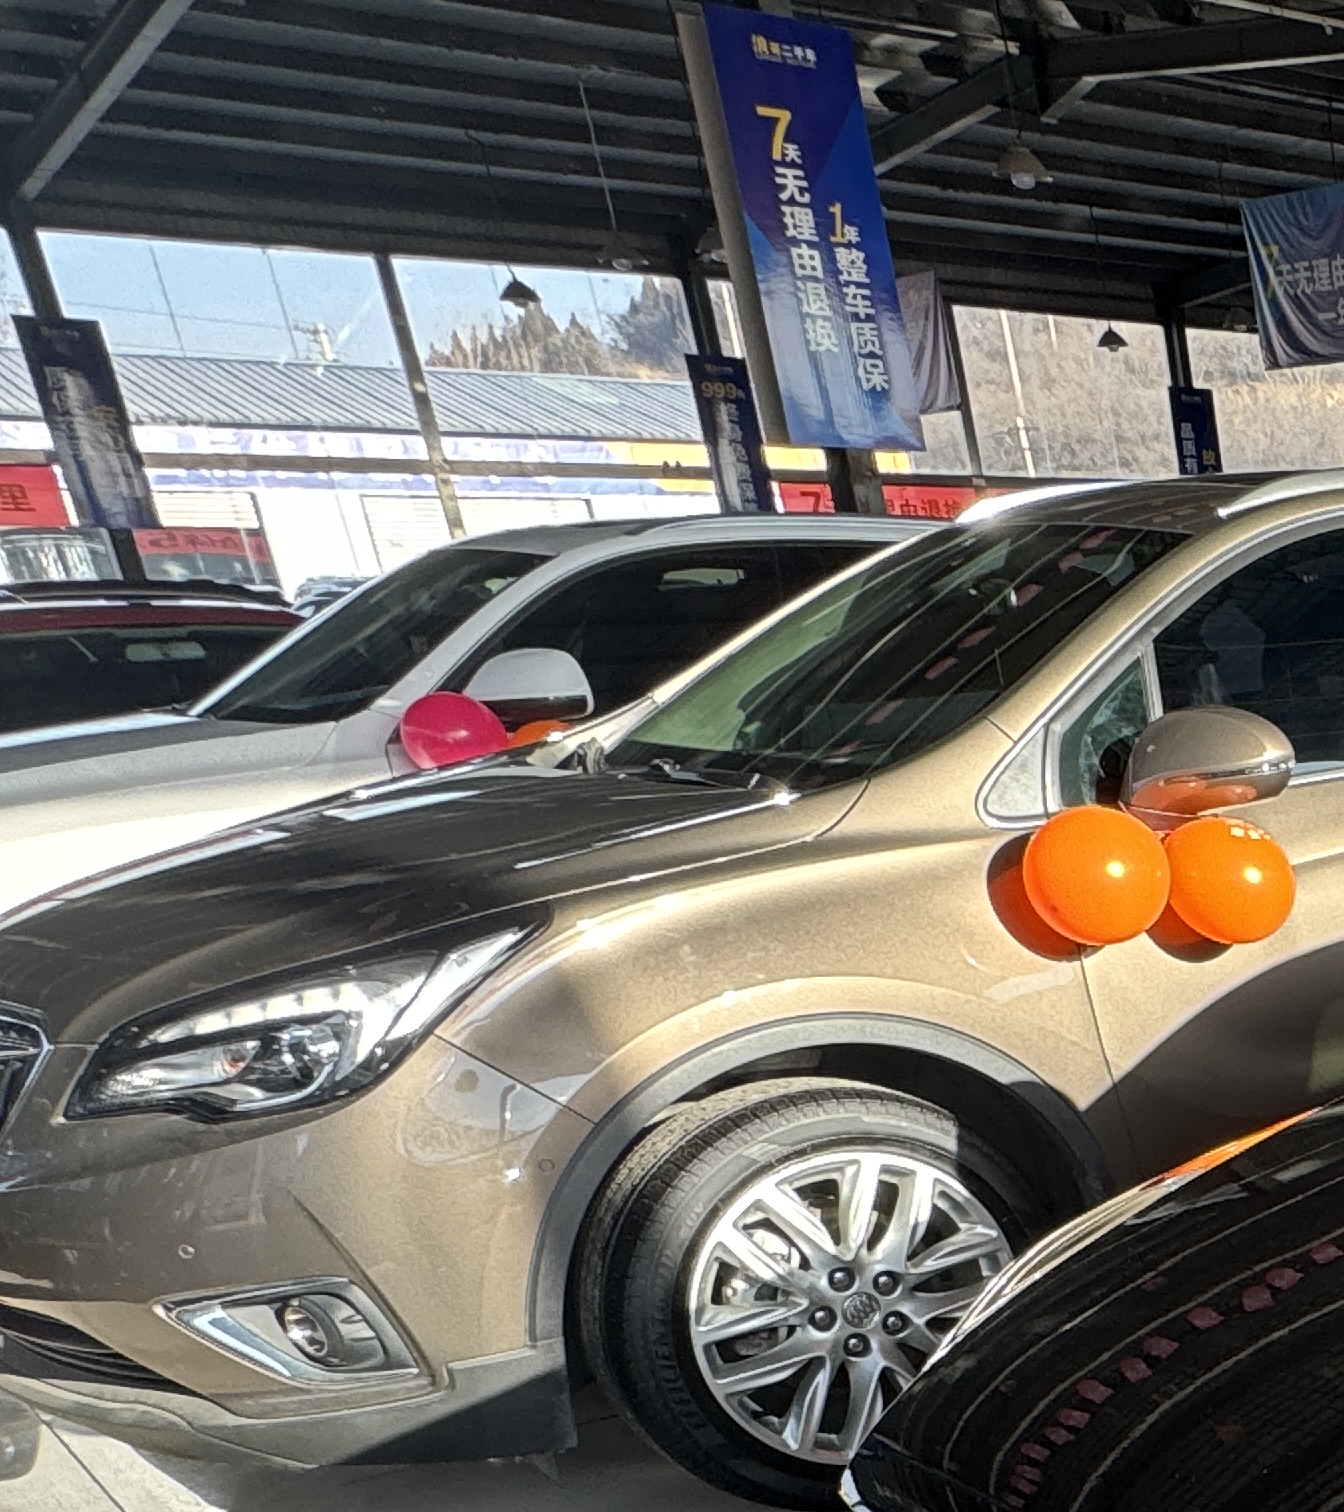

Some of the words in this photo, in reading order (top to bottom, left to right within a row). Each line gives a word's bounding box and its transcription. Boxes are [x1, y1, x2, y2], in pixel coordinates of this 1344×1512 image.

[756, 106, 839, 353] 7天无理由退换
[828, 202, 889, 391] 1年整车质保
